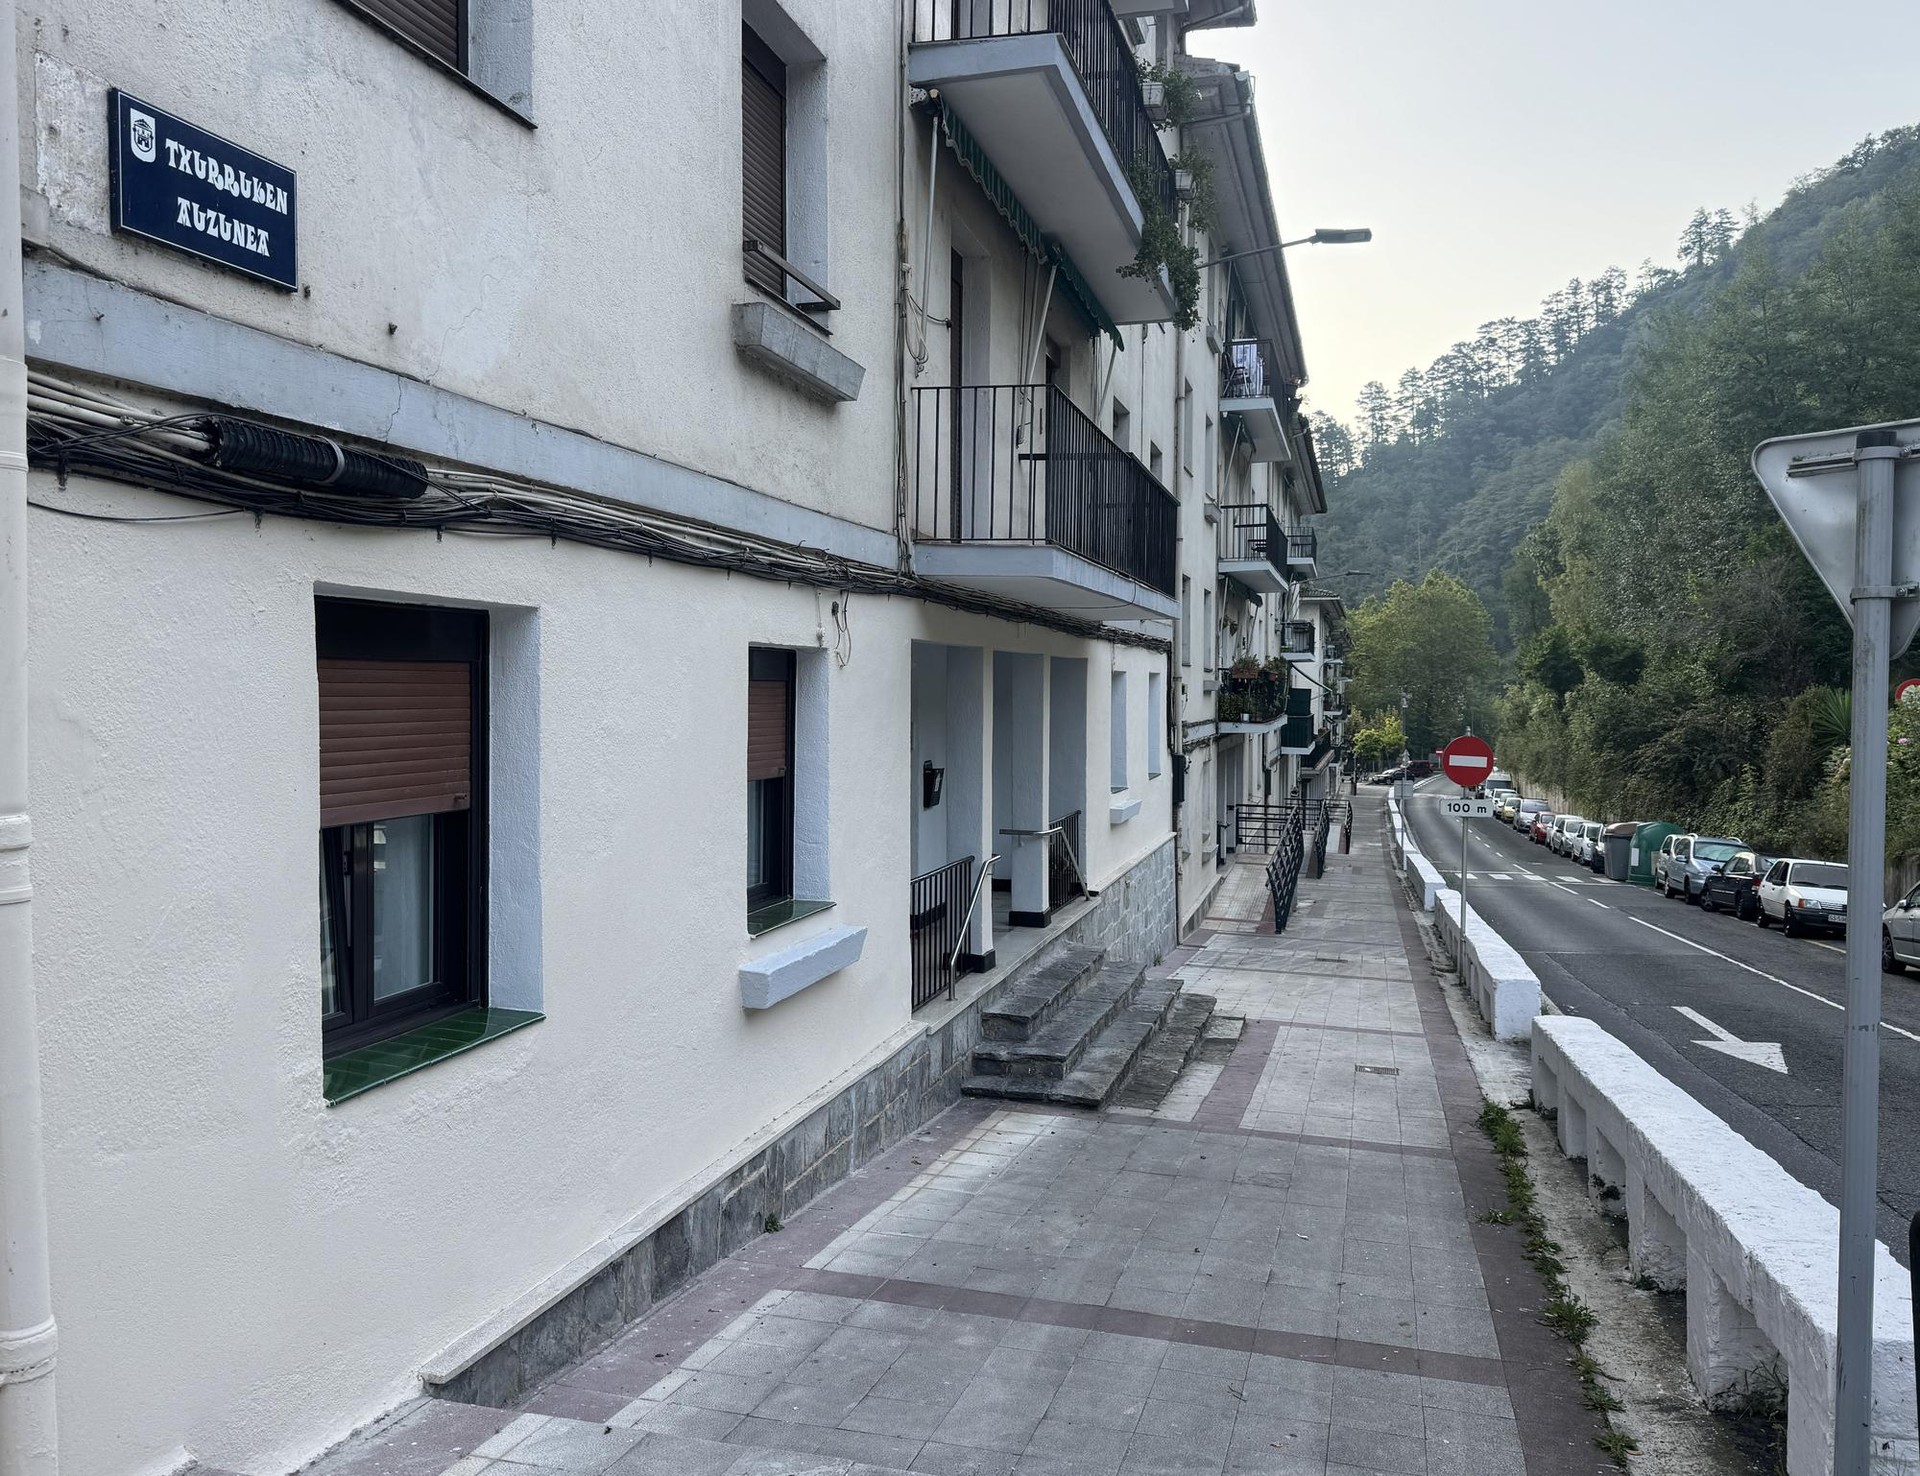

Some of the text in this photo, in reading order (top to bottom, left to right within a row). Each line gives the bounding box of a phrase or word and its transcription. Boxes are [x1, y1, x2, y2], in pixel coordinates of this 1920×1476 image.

[165, 138, 288, 215] TXURRUKEN
[176, 196, 271, 257] AUZUNEA
[1447, 803, 1471, 813] 100
